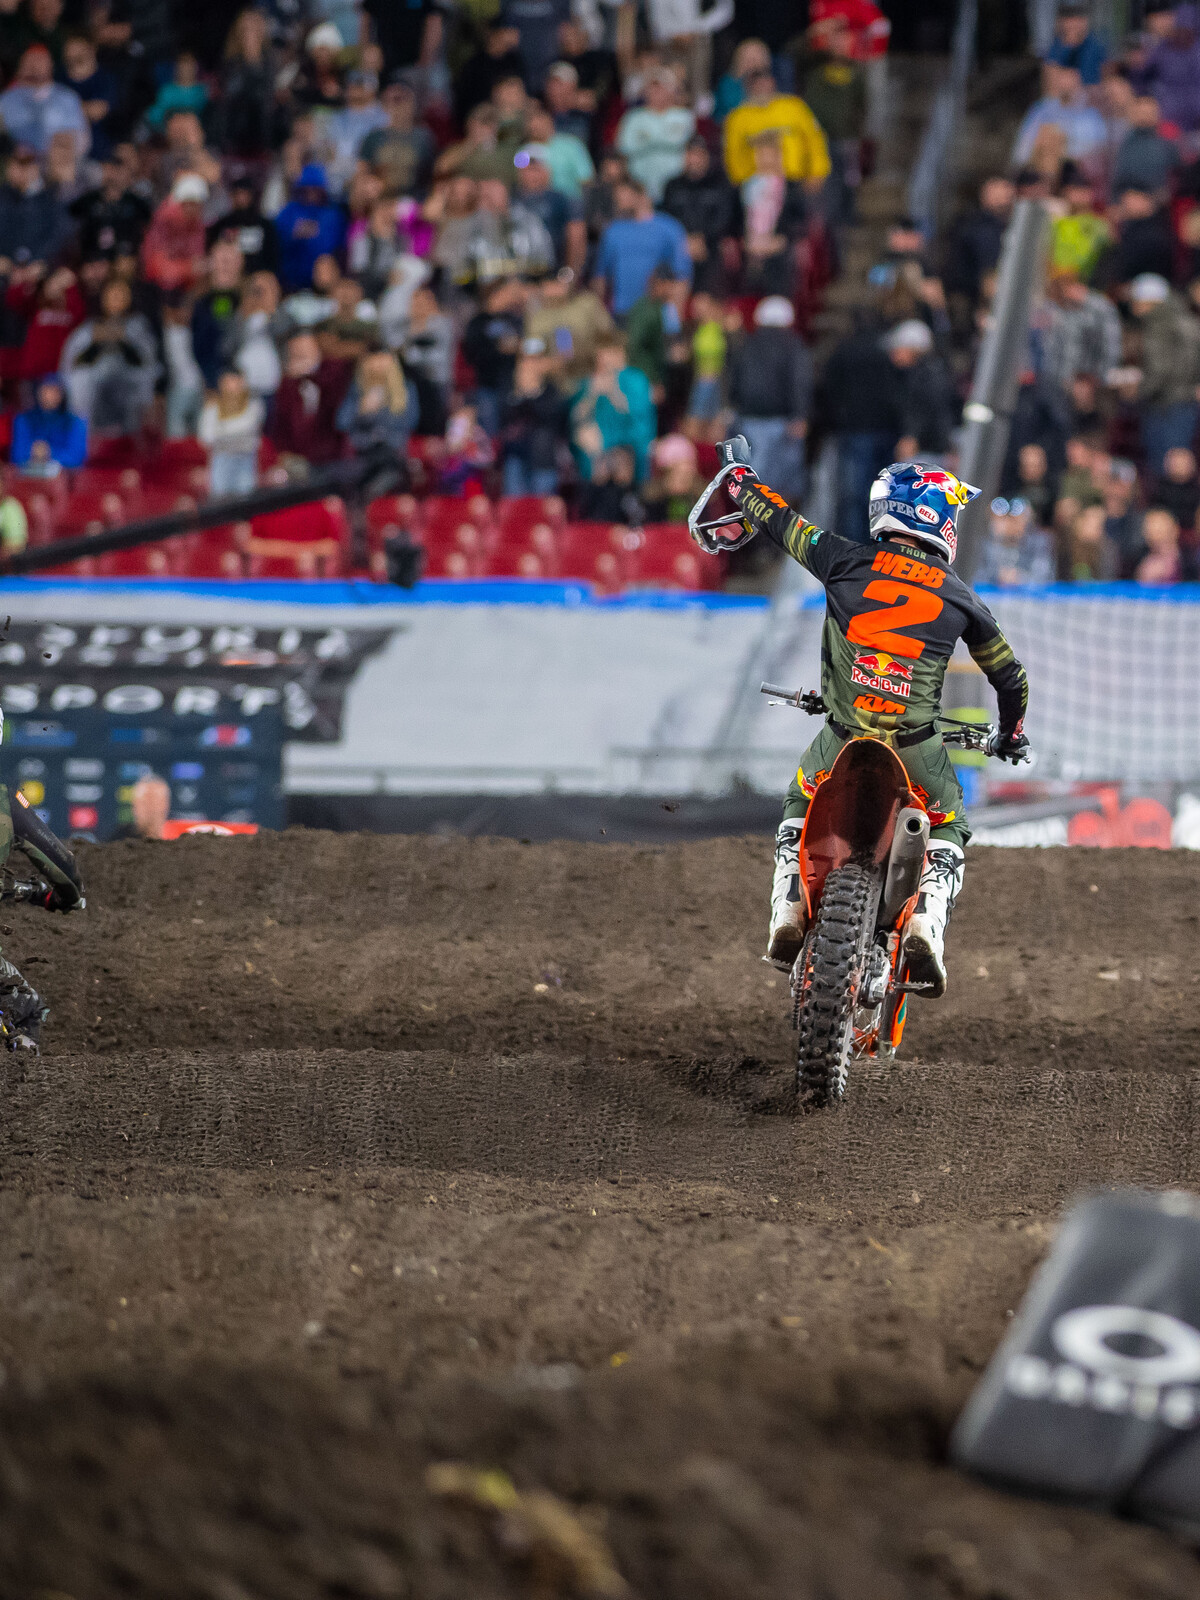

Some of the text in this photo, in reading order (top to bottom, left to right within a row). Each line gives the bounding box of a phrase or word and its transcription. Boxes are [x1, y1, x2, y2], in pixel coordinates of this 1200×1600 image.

[741, 490, 774, 524] THOR
[869, 500, 917, 520] COOPER
[919, 507, 936, 522] BELL
[900, 545, 927, 560] THOR
[871, 551, 947, 589] WEBB
[846, 579, 944, 660] 2
[851, 666, 911, 698] Red Bull
[853, 694, 907, 714] KTM
